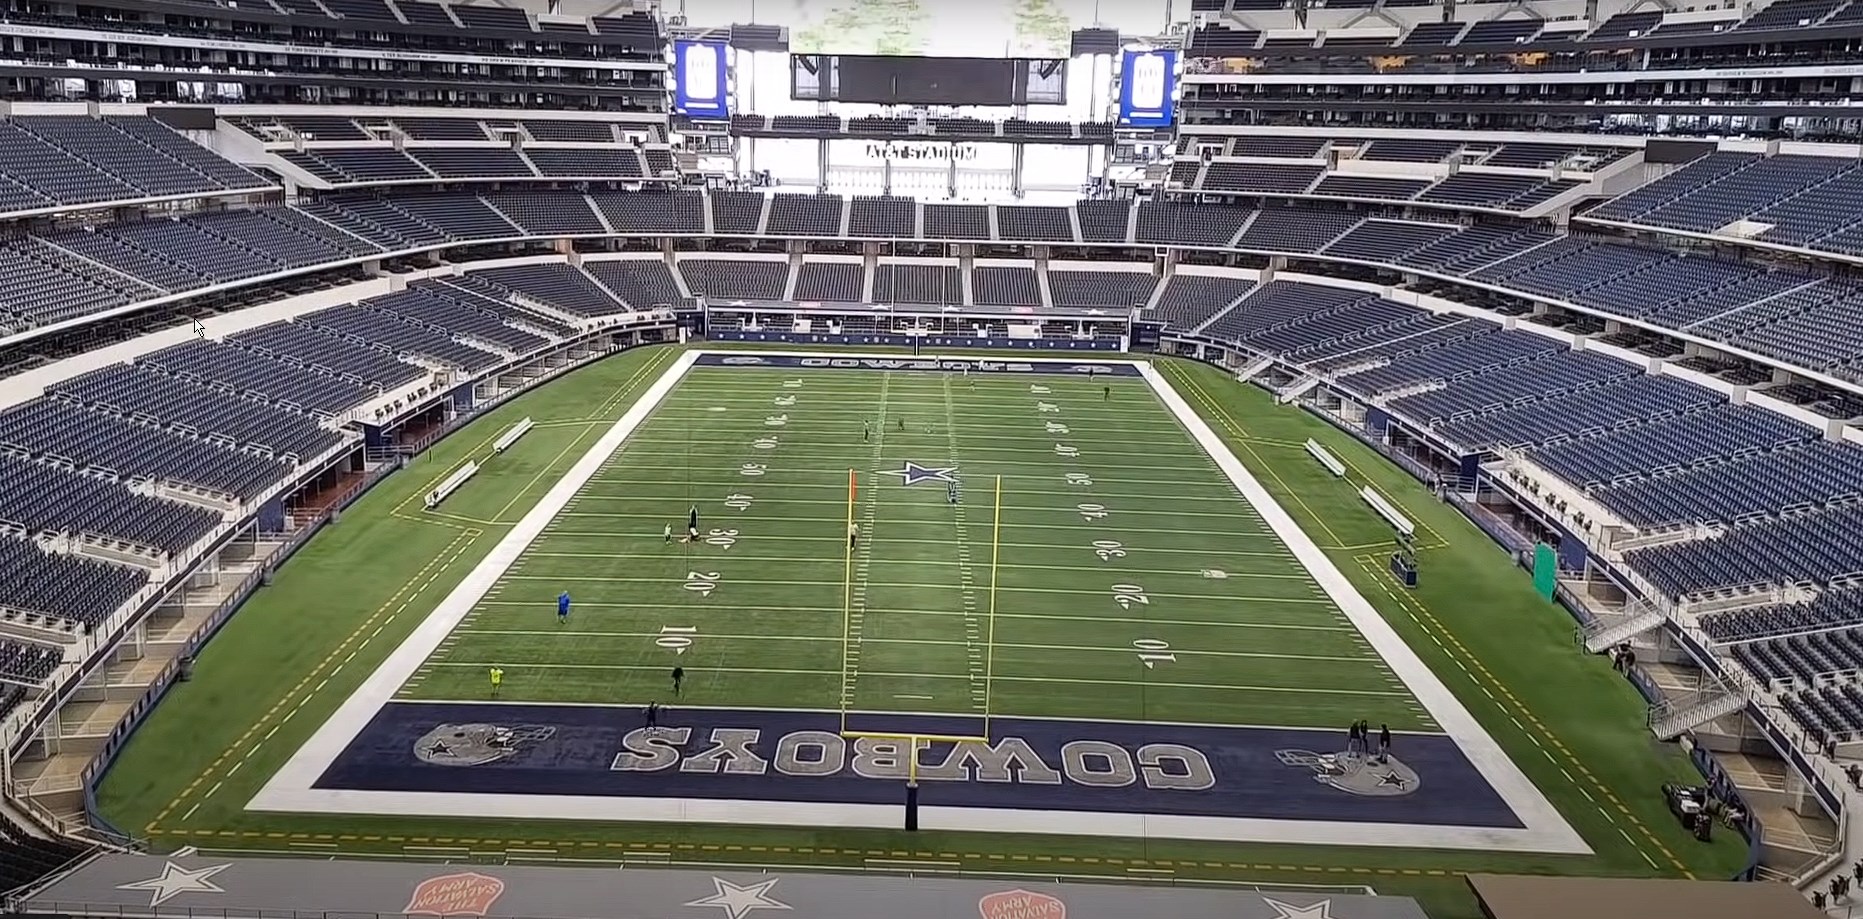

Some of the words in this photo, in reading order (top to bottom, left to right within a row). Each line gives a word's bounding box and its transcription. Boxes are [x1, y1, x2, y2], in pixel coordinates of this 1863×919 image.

[866, 144, 904, 161] AT&T
[907, 144, 978, 161] STADIUM
[740, 463, 767, 476] 50
[1065, 473, 1093, 486] 50
[724, 493, 754, 507] 40
[1077, 503, 1109, 518] 40
[705, 528, 739, 545] 30
[1092, 540, 1127, 558] 30
[683, 571, 721, 591] 20
[1111, 583, 1149, 604] 20
[655, 625, 697, 648] 10
[1133, 639, 1177, 662] 10
[609, 727, 1217, 790] COWBOYS
[412, 883, 500, 910] SALVATION
[423, 877, 479, 898] ARMY
[991, 895, 1033, 915] ARMY
